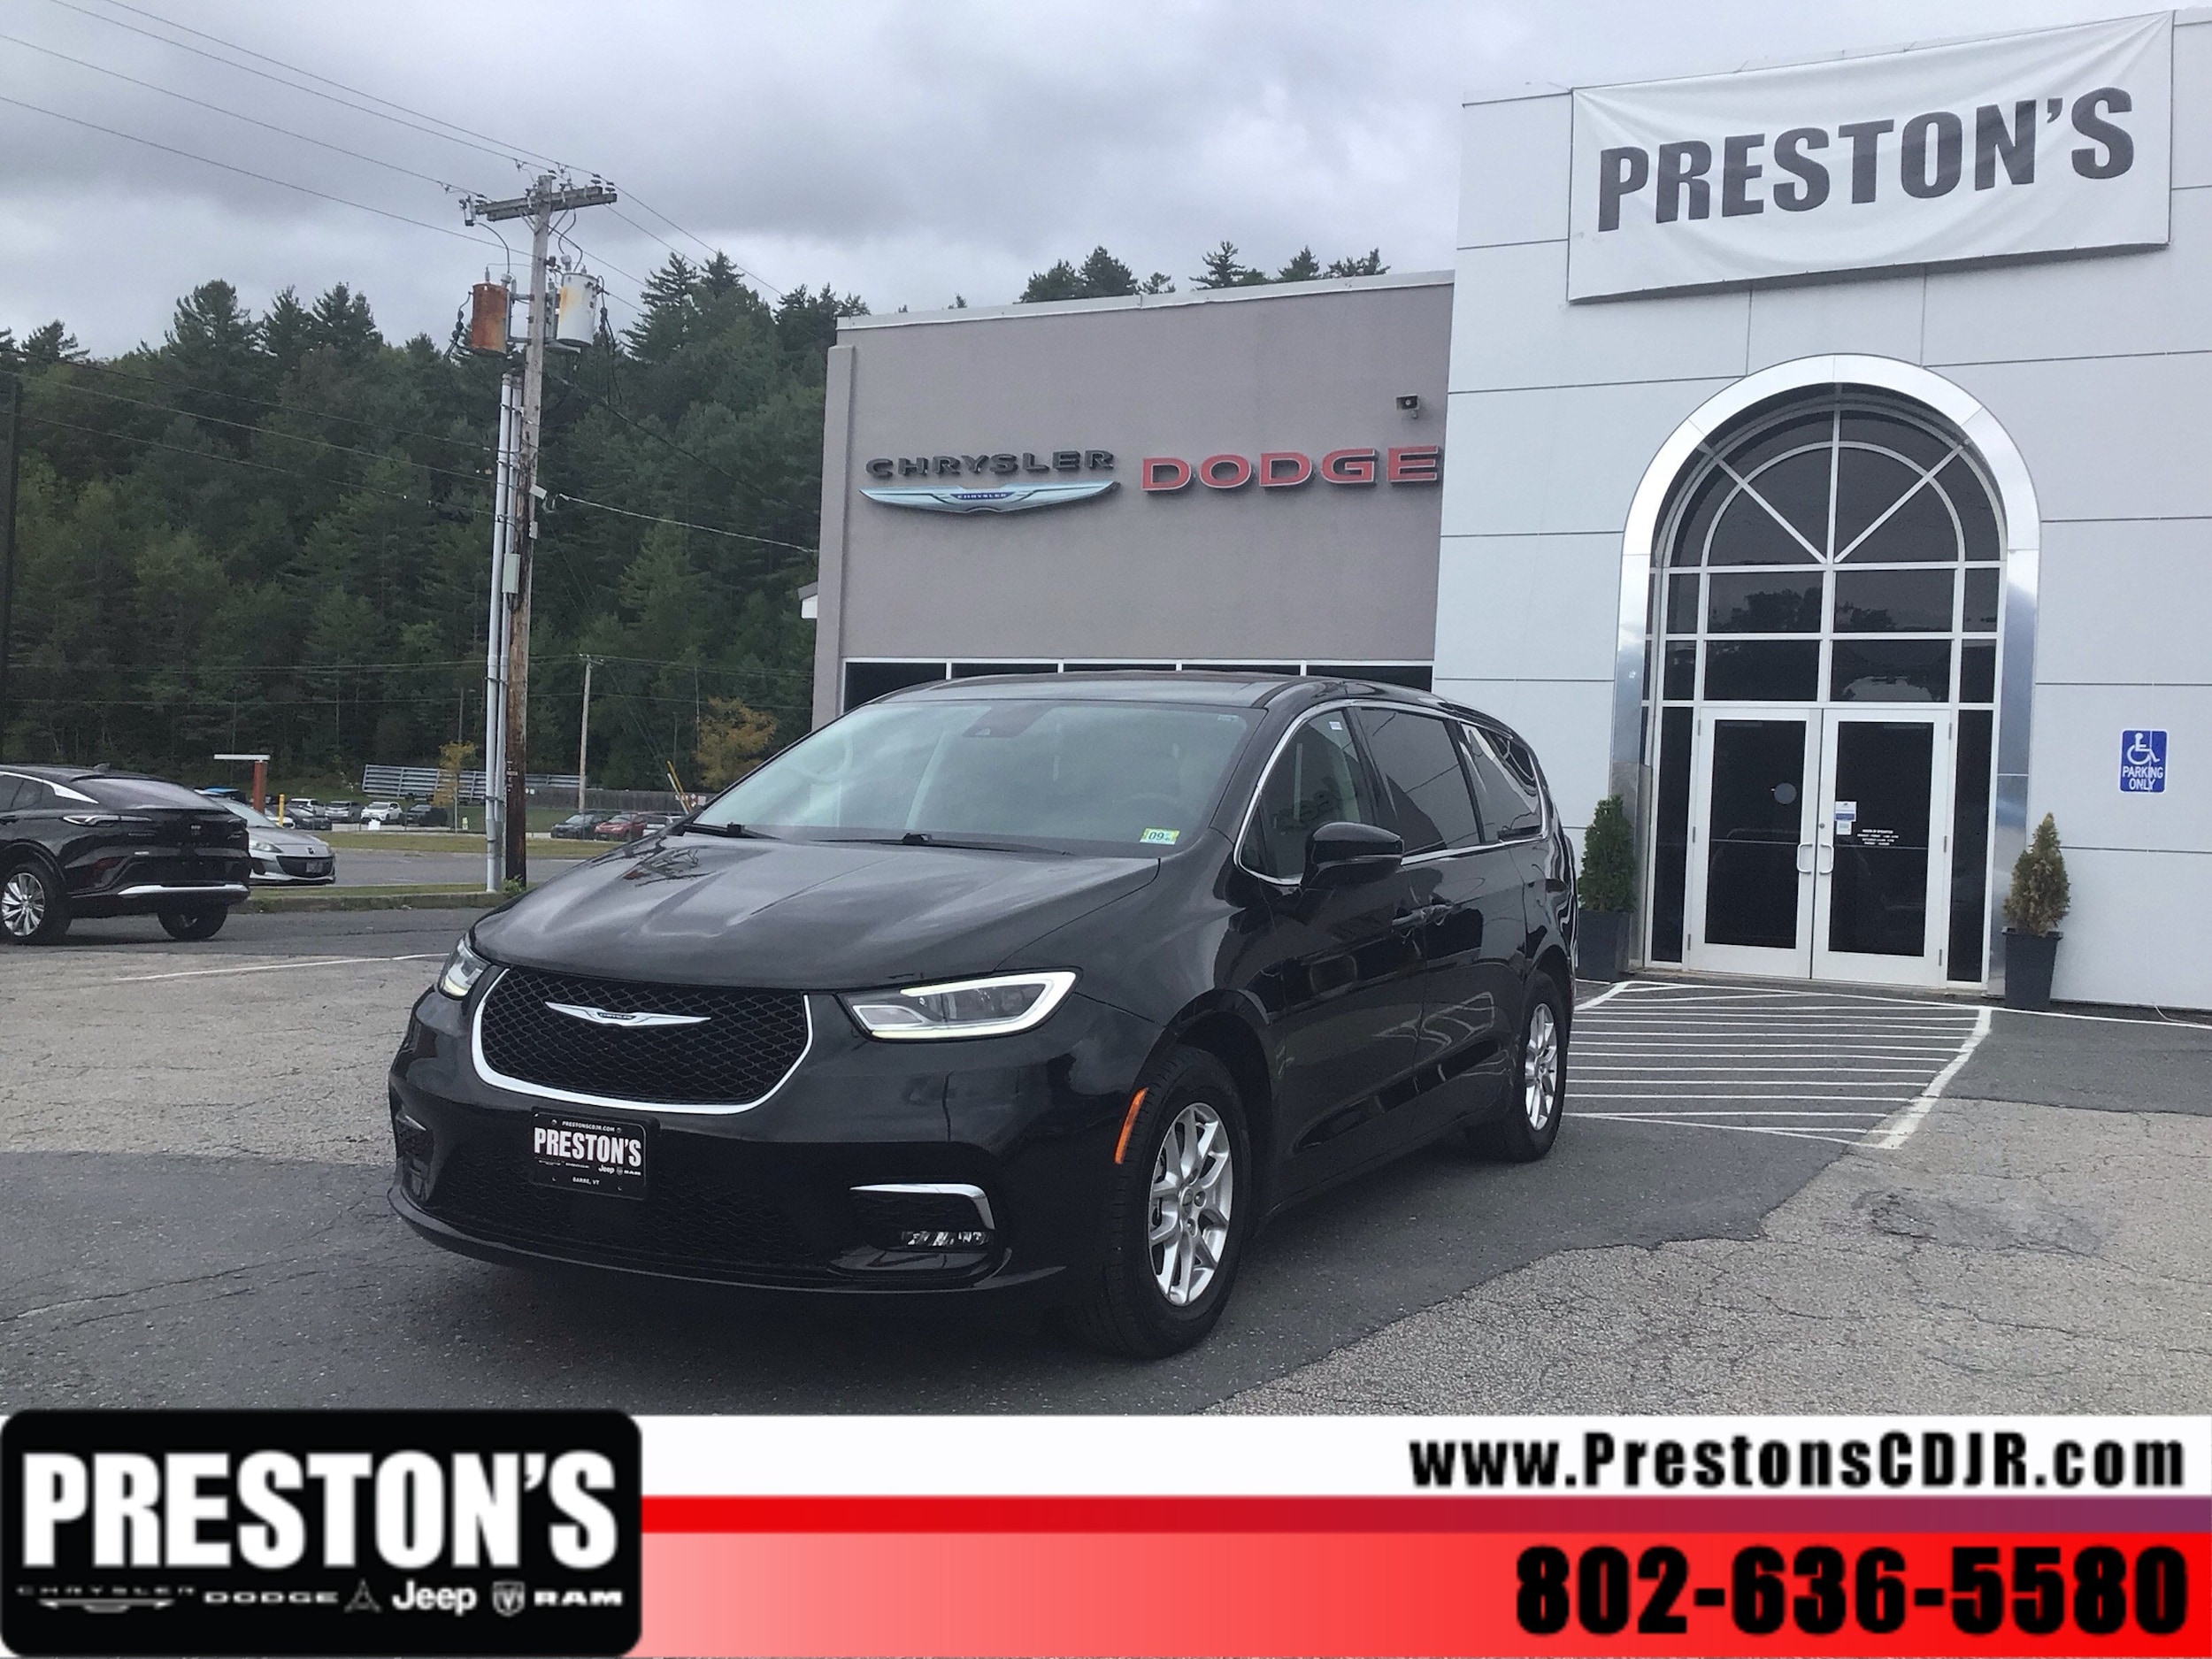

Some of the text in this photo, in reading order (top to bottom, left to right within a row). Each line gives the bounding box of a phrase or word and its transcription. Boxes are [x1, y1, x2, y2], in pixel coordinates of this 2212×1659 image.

[1598, 87, 2134, 232] PRESTON'S
[865, 449, 1115, 478] CHRYSLER
[1141, 445, 1440, 492] DODGE
[2123, 765, 2164, 779] PARKING
[2129, 778, 2155, 790] ONLY
[534, 1127, 642, 1168] PRESTON'S
[598, 1164, 615, 1175] Jeep
